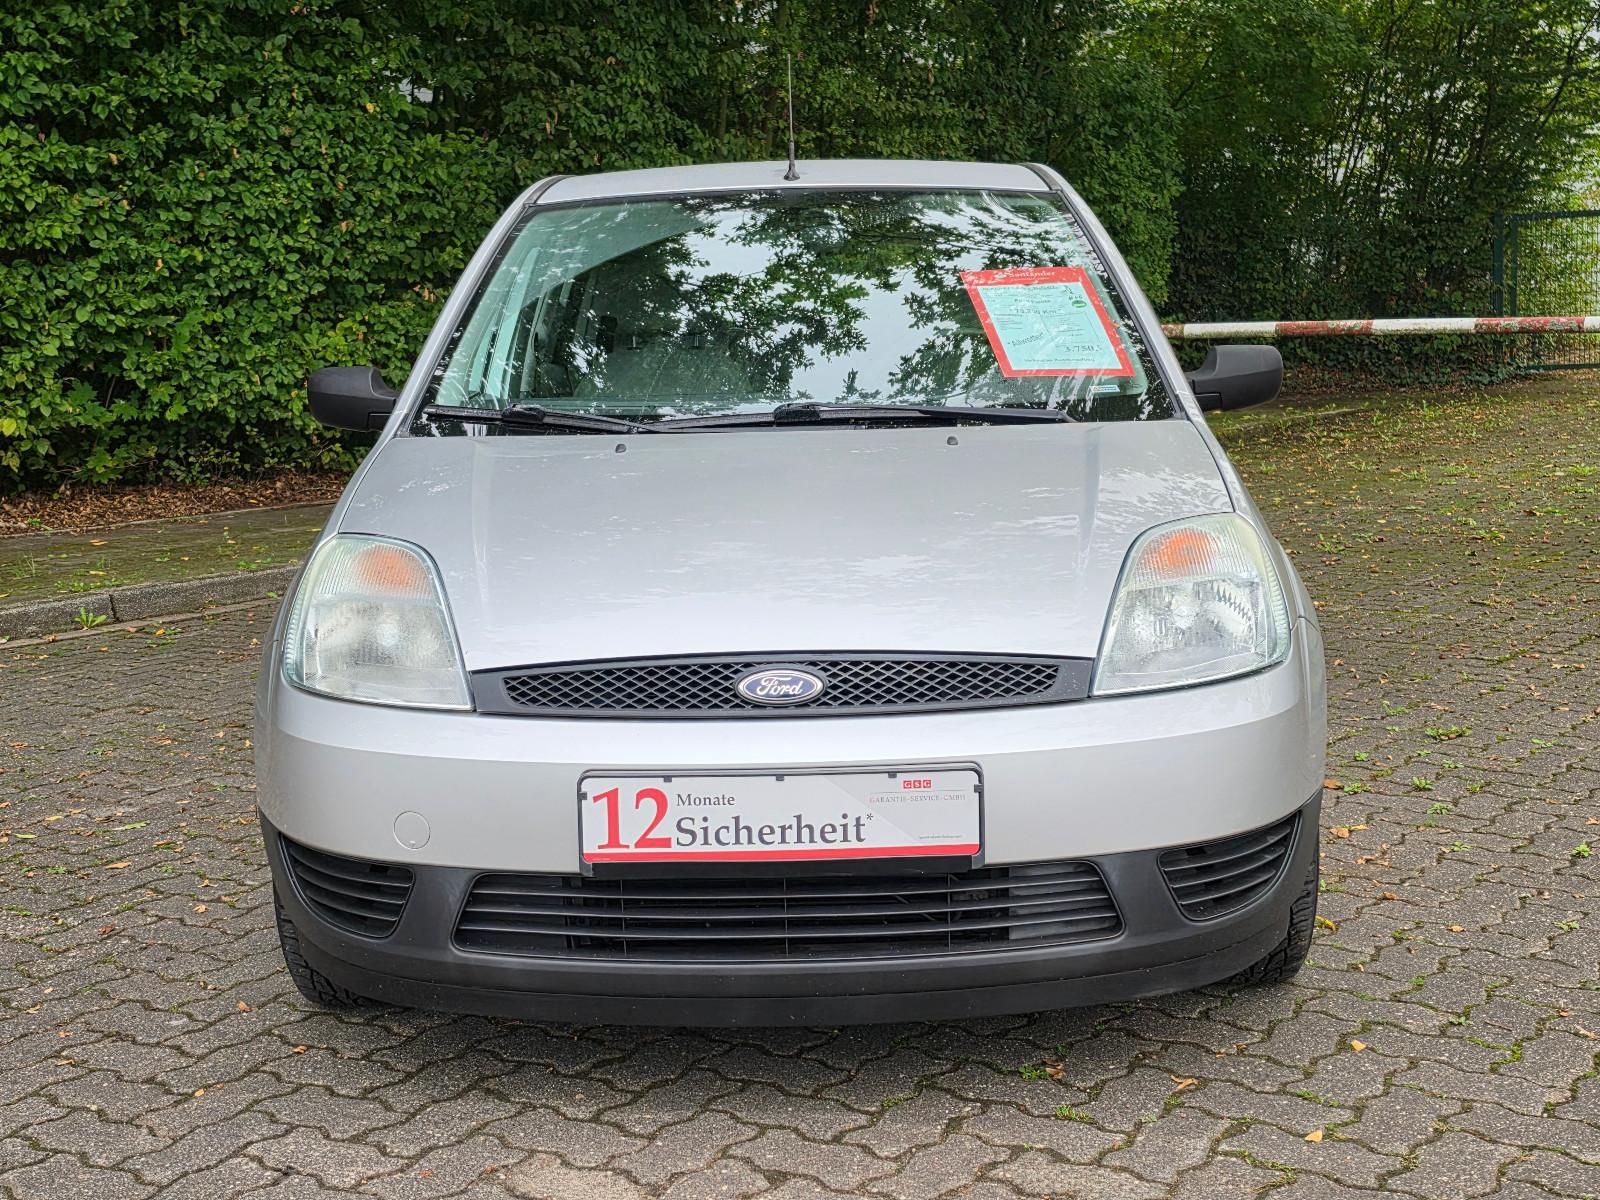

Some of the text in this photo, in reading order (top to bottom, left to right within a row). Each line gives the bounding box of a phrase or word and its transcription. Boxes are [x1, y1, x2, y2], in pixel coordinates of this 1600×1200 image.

[756, 676, 804, 695] Ford
[903, 780, 932, 788] GSG
[676, 793, 735, 807] Monate
[592, 786, 672, 850] 12
